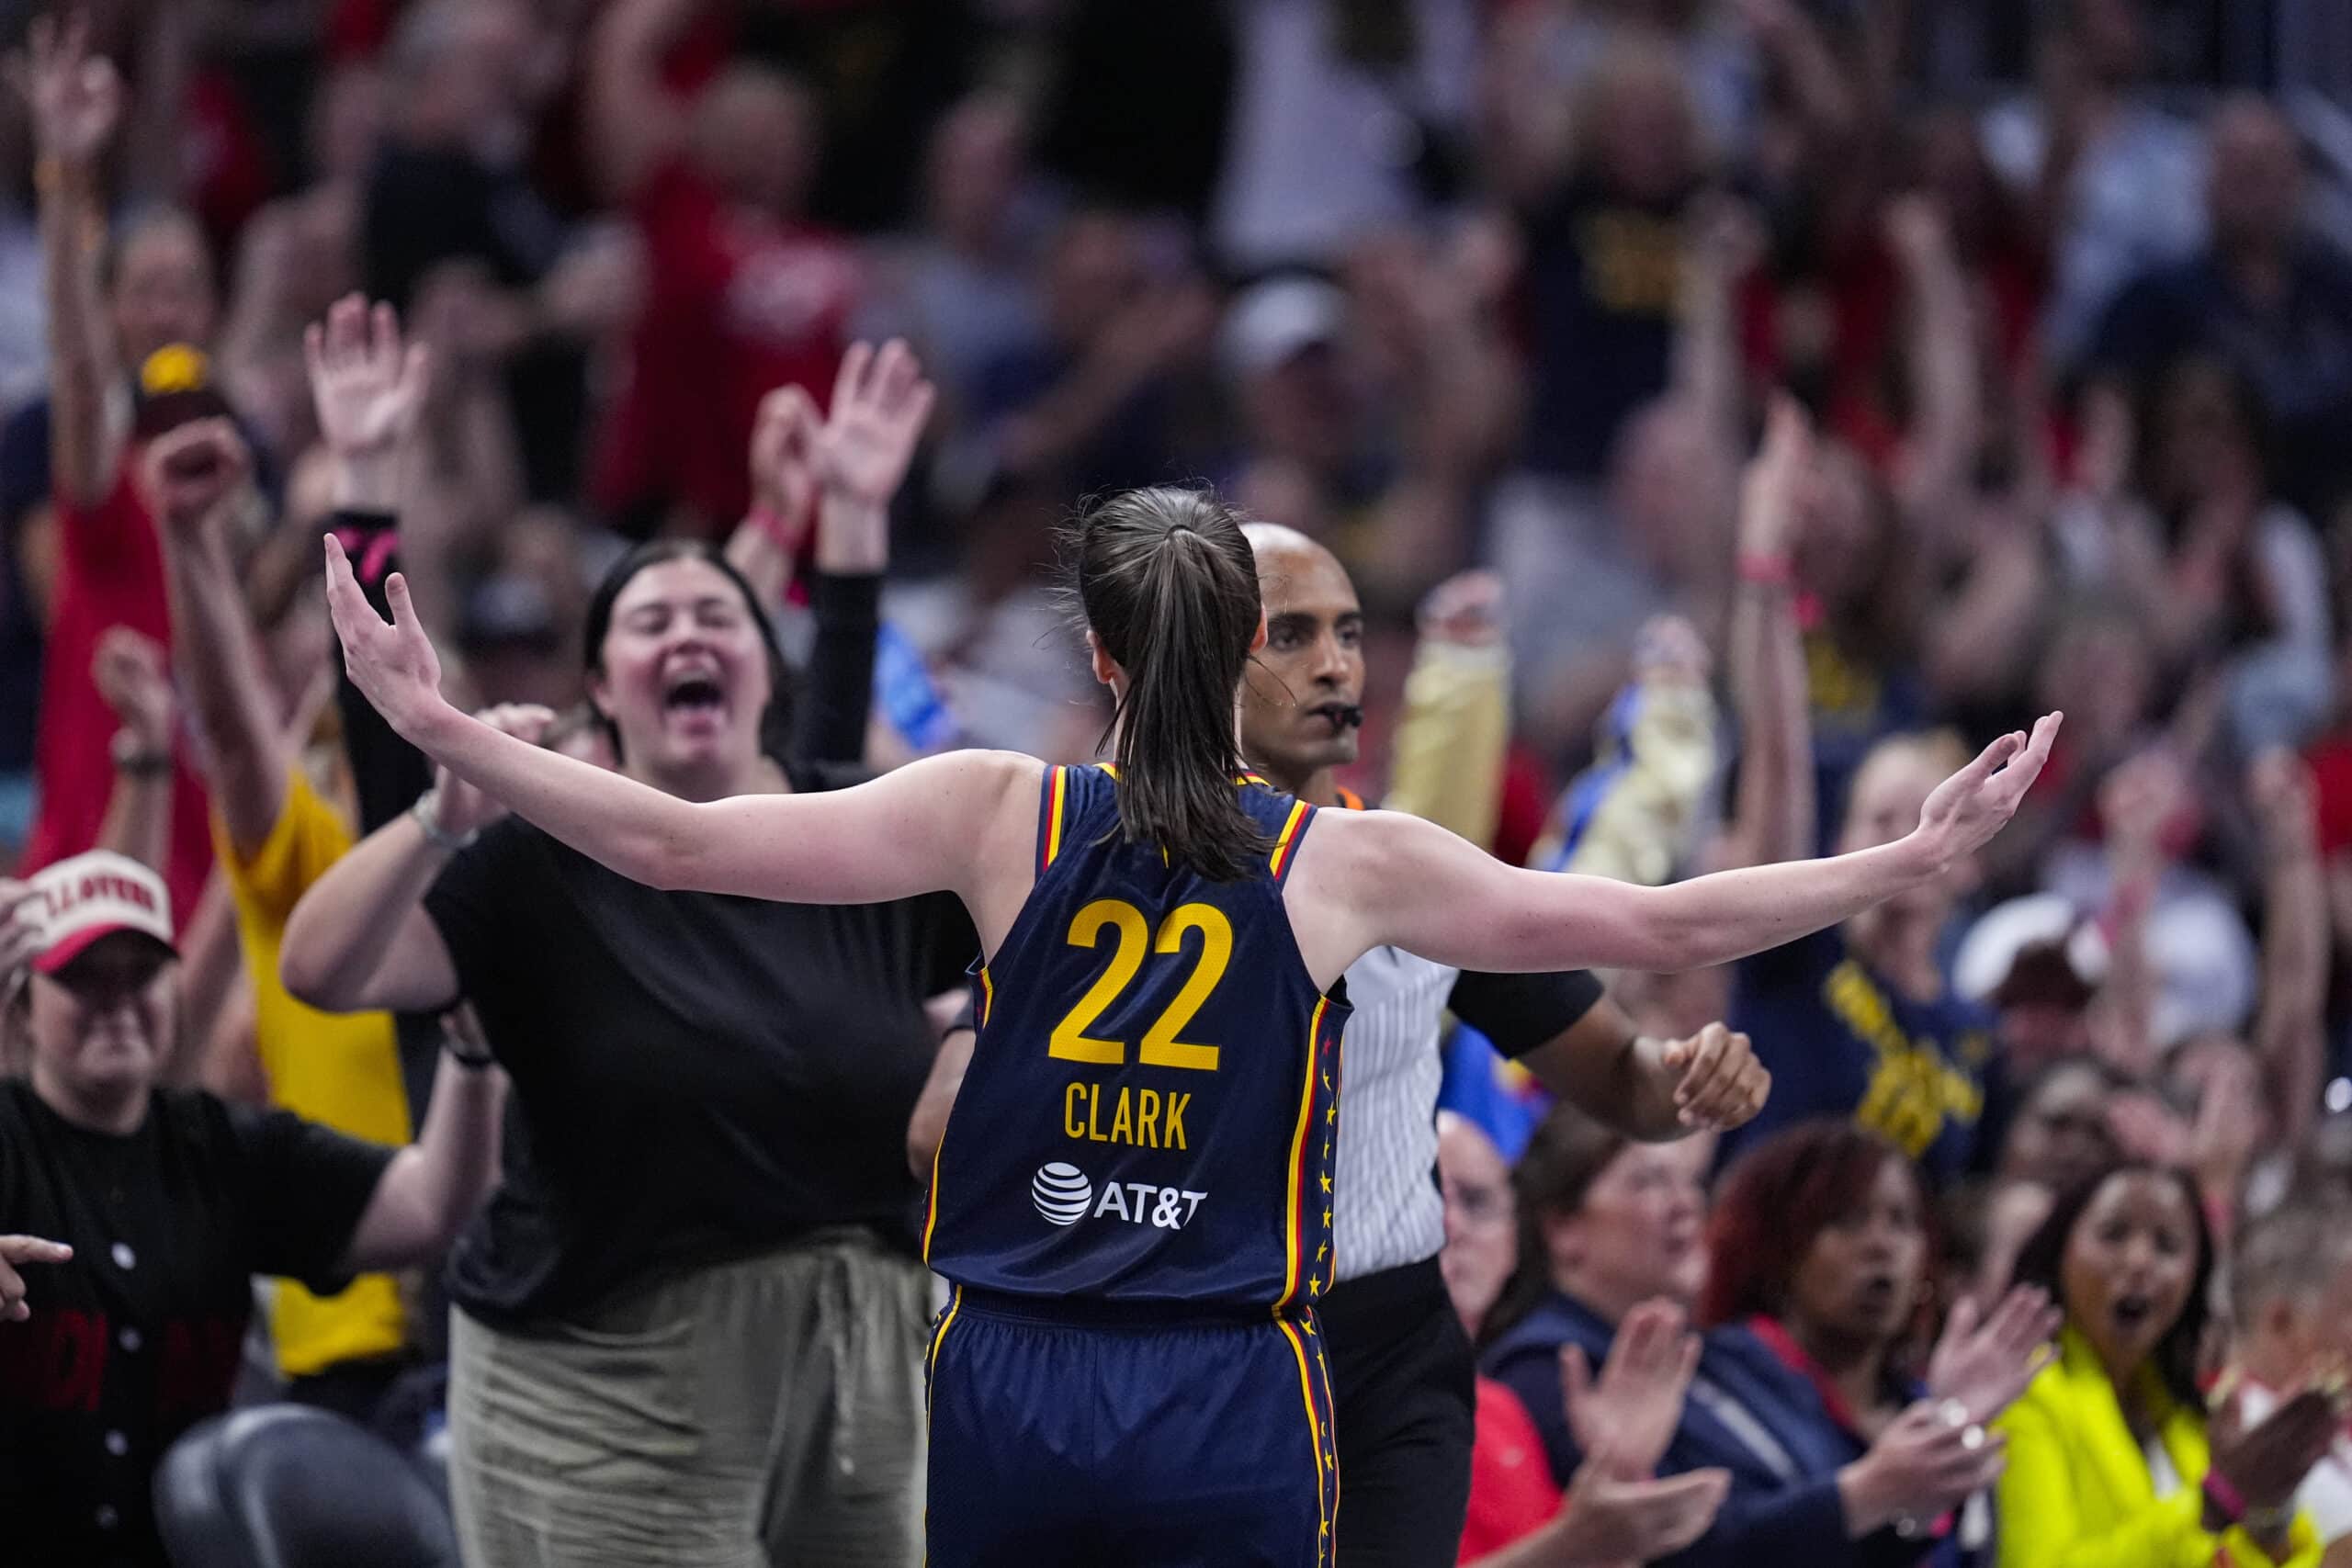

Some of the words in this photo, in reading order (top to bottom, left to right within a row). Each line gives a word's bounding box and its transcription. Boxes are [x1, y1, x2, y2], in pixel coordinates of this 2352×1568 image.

[1048, 898, 1234, 1071] 22
[1065, 1081, 1192, 1150] CLARK
[1093, 1181, 1208, 1230] AT&T
